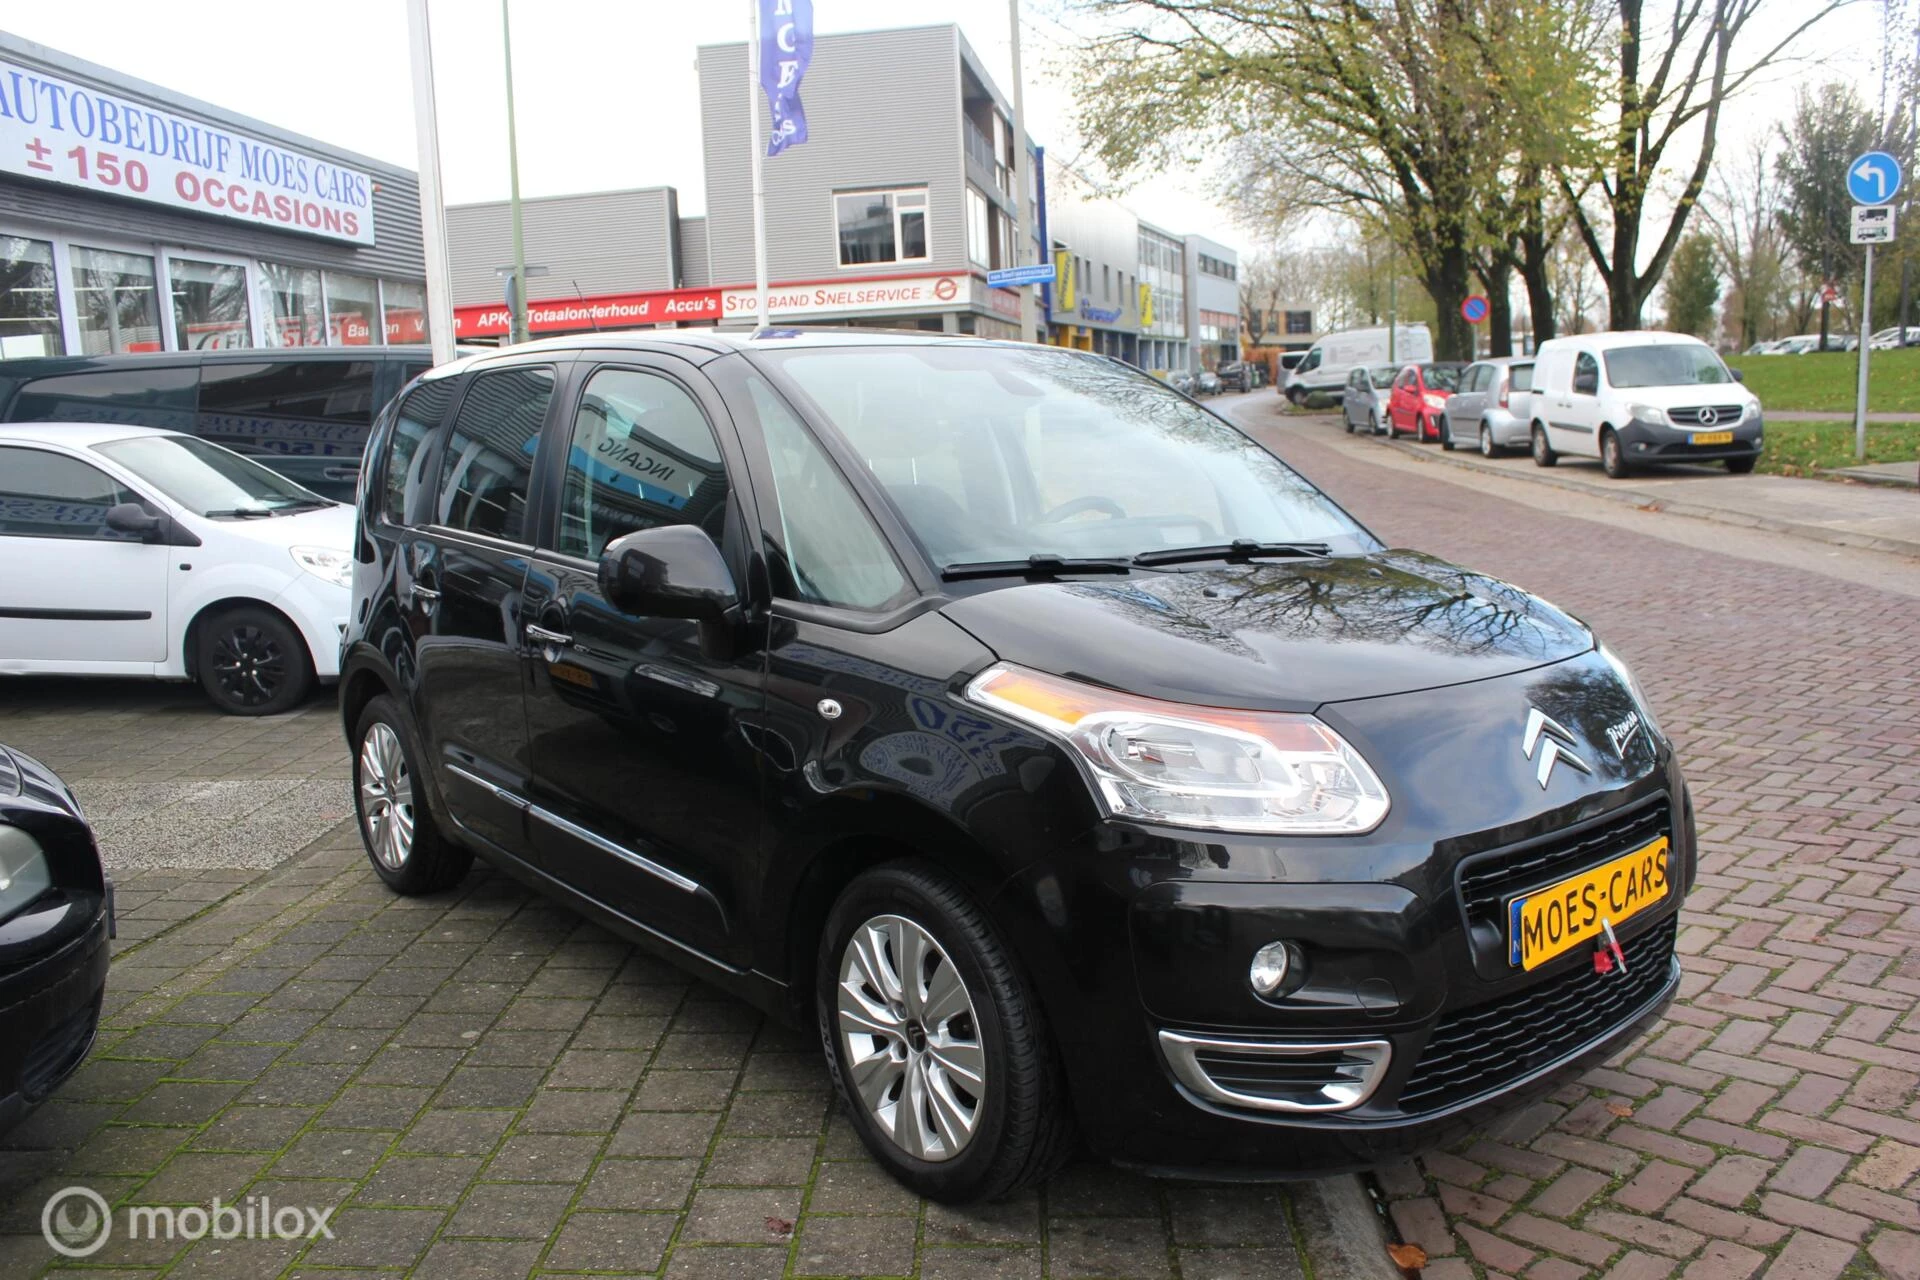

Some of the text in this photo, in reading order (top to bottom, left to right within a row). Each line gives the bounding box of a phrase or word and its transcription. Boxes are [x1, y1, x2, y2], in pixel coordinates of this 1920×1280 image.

[67, 145, 149, 193] 150
[175, 171, 359, 236] OCCASIONS
[239, 141, 308, 194] MOES
[314, 164, 367, 208] CARS
[477, 313, 509, 328] APK
[527, 302, 649, 323] Totaalonderhoud
[665, 296, 716, 314] Accu's
[726, 287, 921, 311] STOBAND SNELSERVICE
[1523, 848, 1667, 960] MOES-CARS
